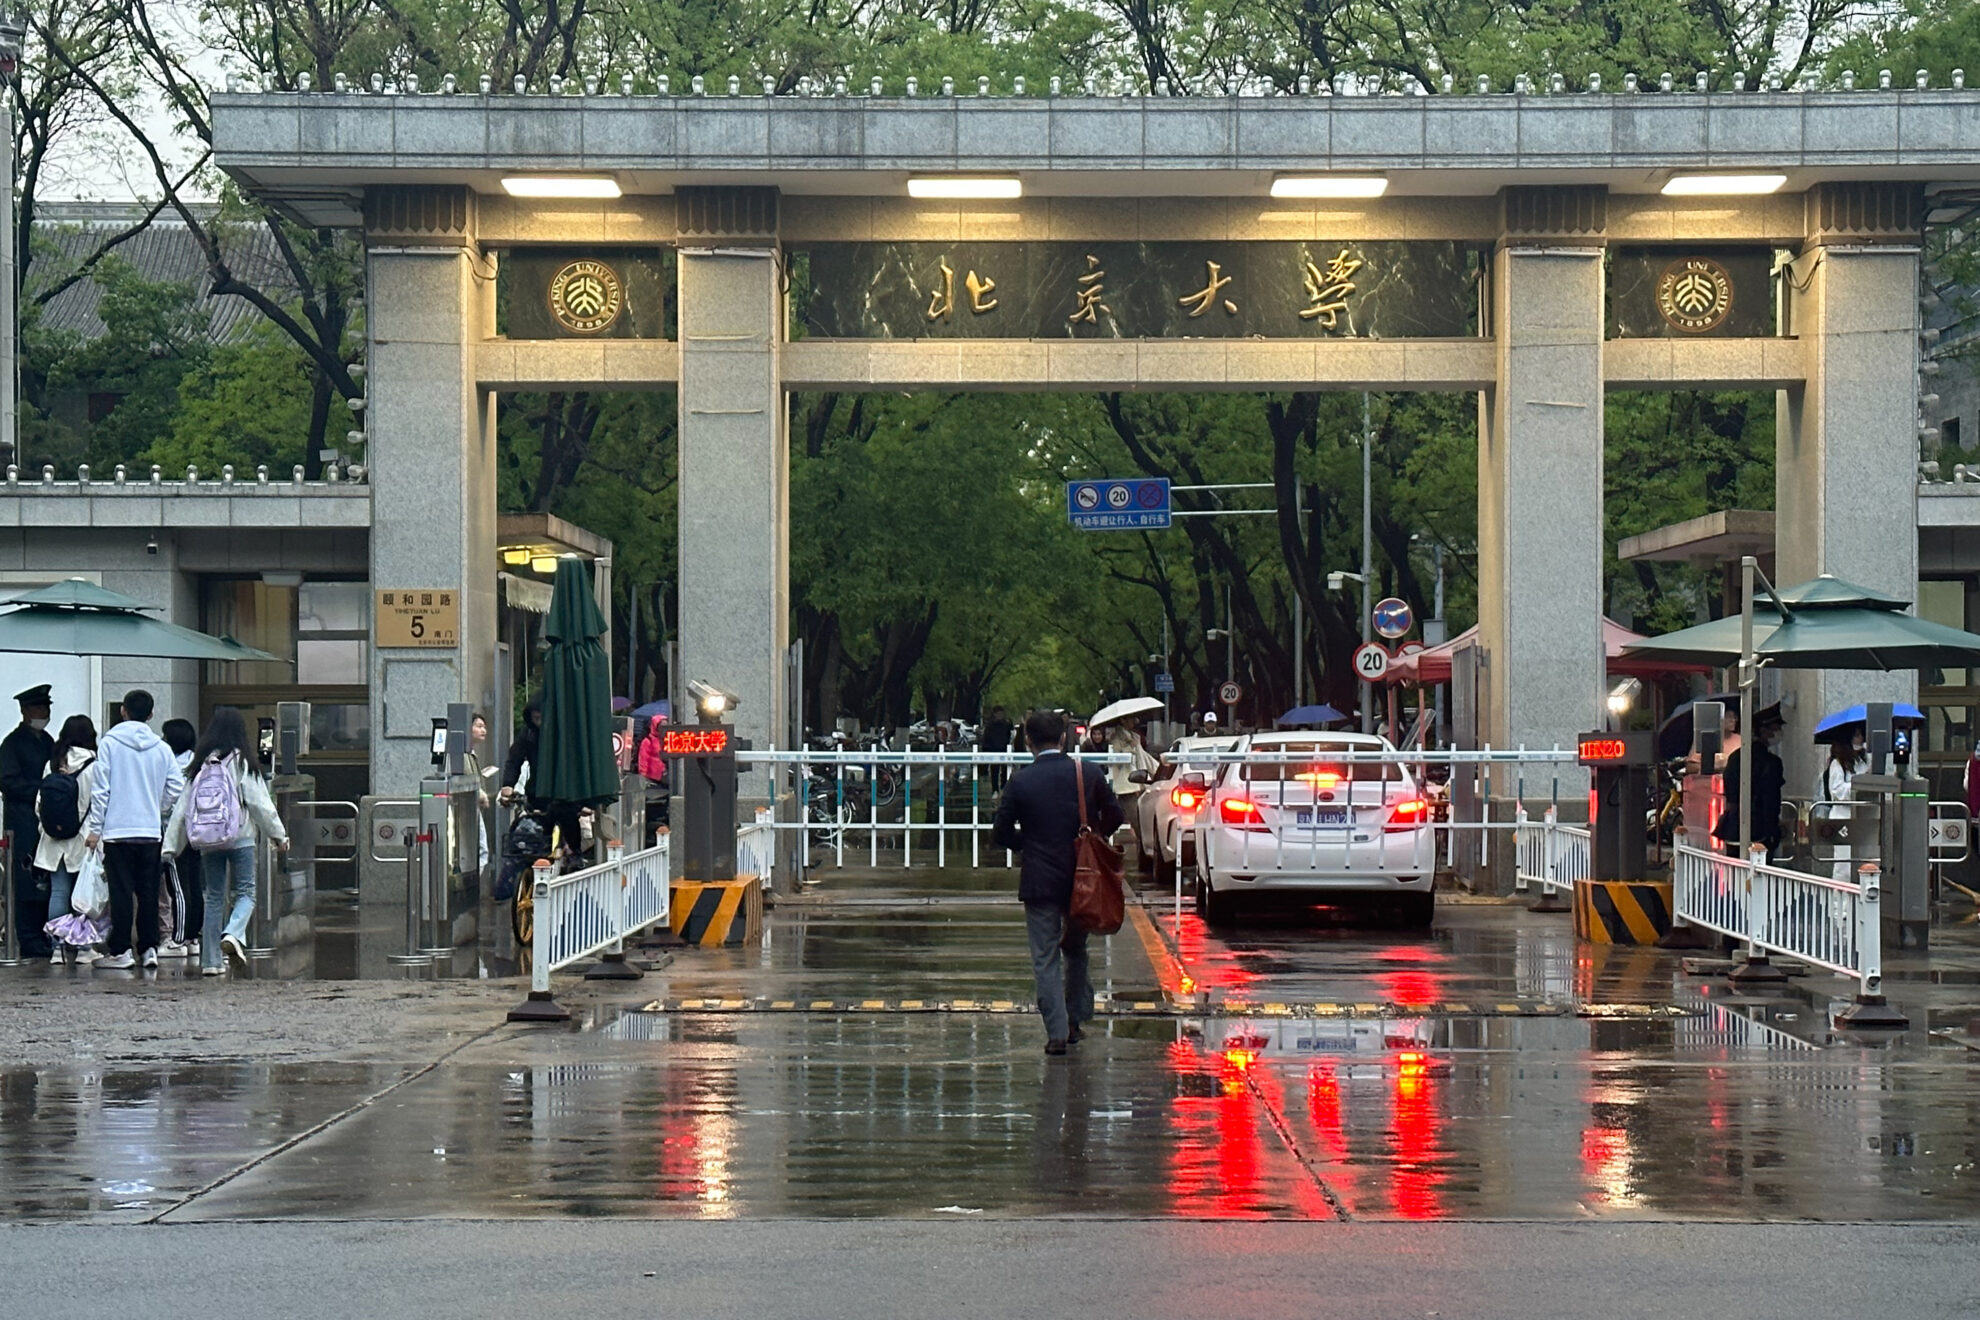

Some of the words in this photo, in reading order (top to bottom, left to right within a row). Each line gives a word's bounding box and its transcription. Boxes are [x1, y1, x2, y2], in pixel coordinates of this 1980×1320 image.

[552, 274, 568, 316] PEKING
[1661, 273, 1675, 316] PEKNG
[1687, 261, 1728, 314] UNIERSITY
[1112, 490, 1126, 503] 20
[382, 593, 451, 606] 颐和园路
[411, 615, 425, 639] 5
[1363, 652, 1383, 671] 20
[1224, 687, 1237, 699] 20
[663, 730, 728, 753] 北京大学
